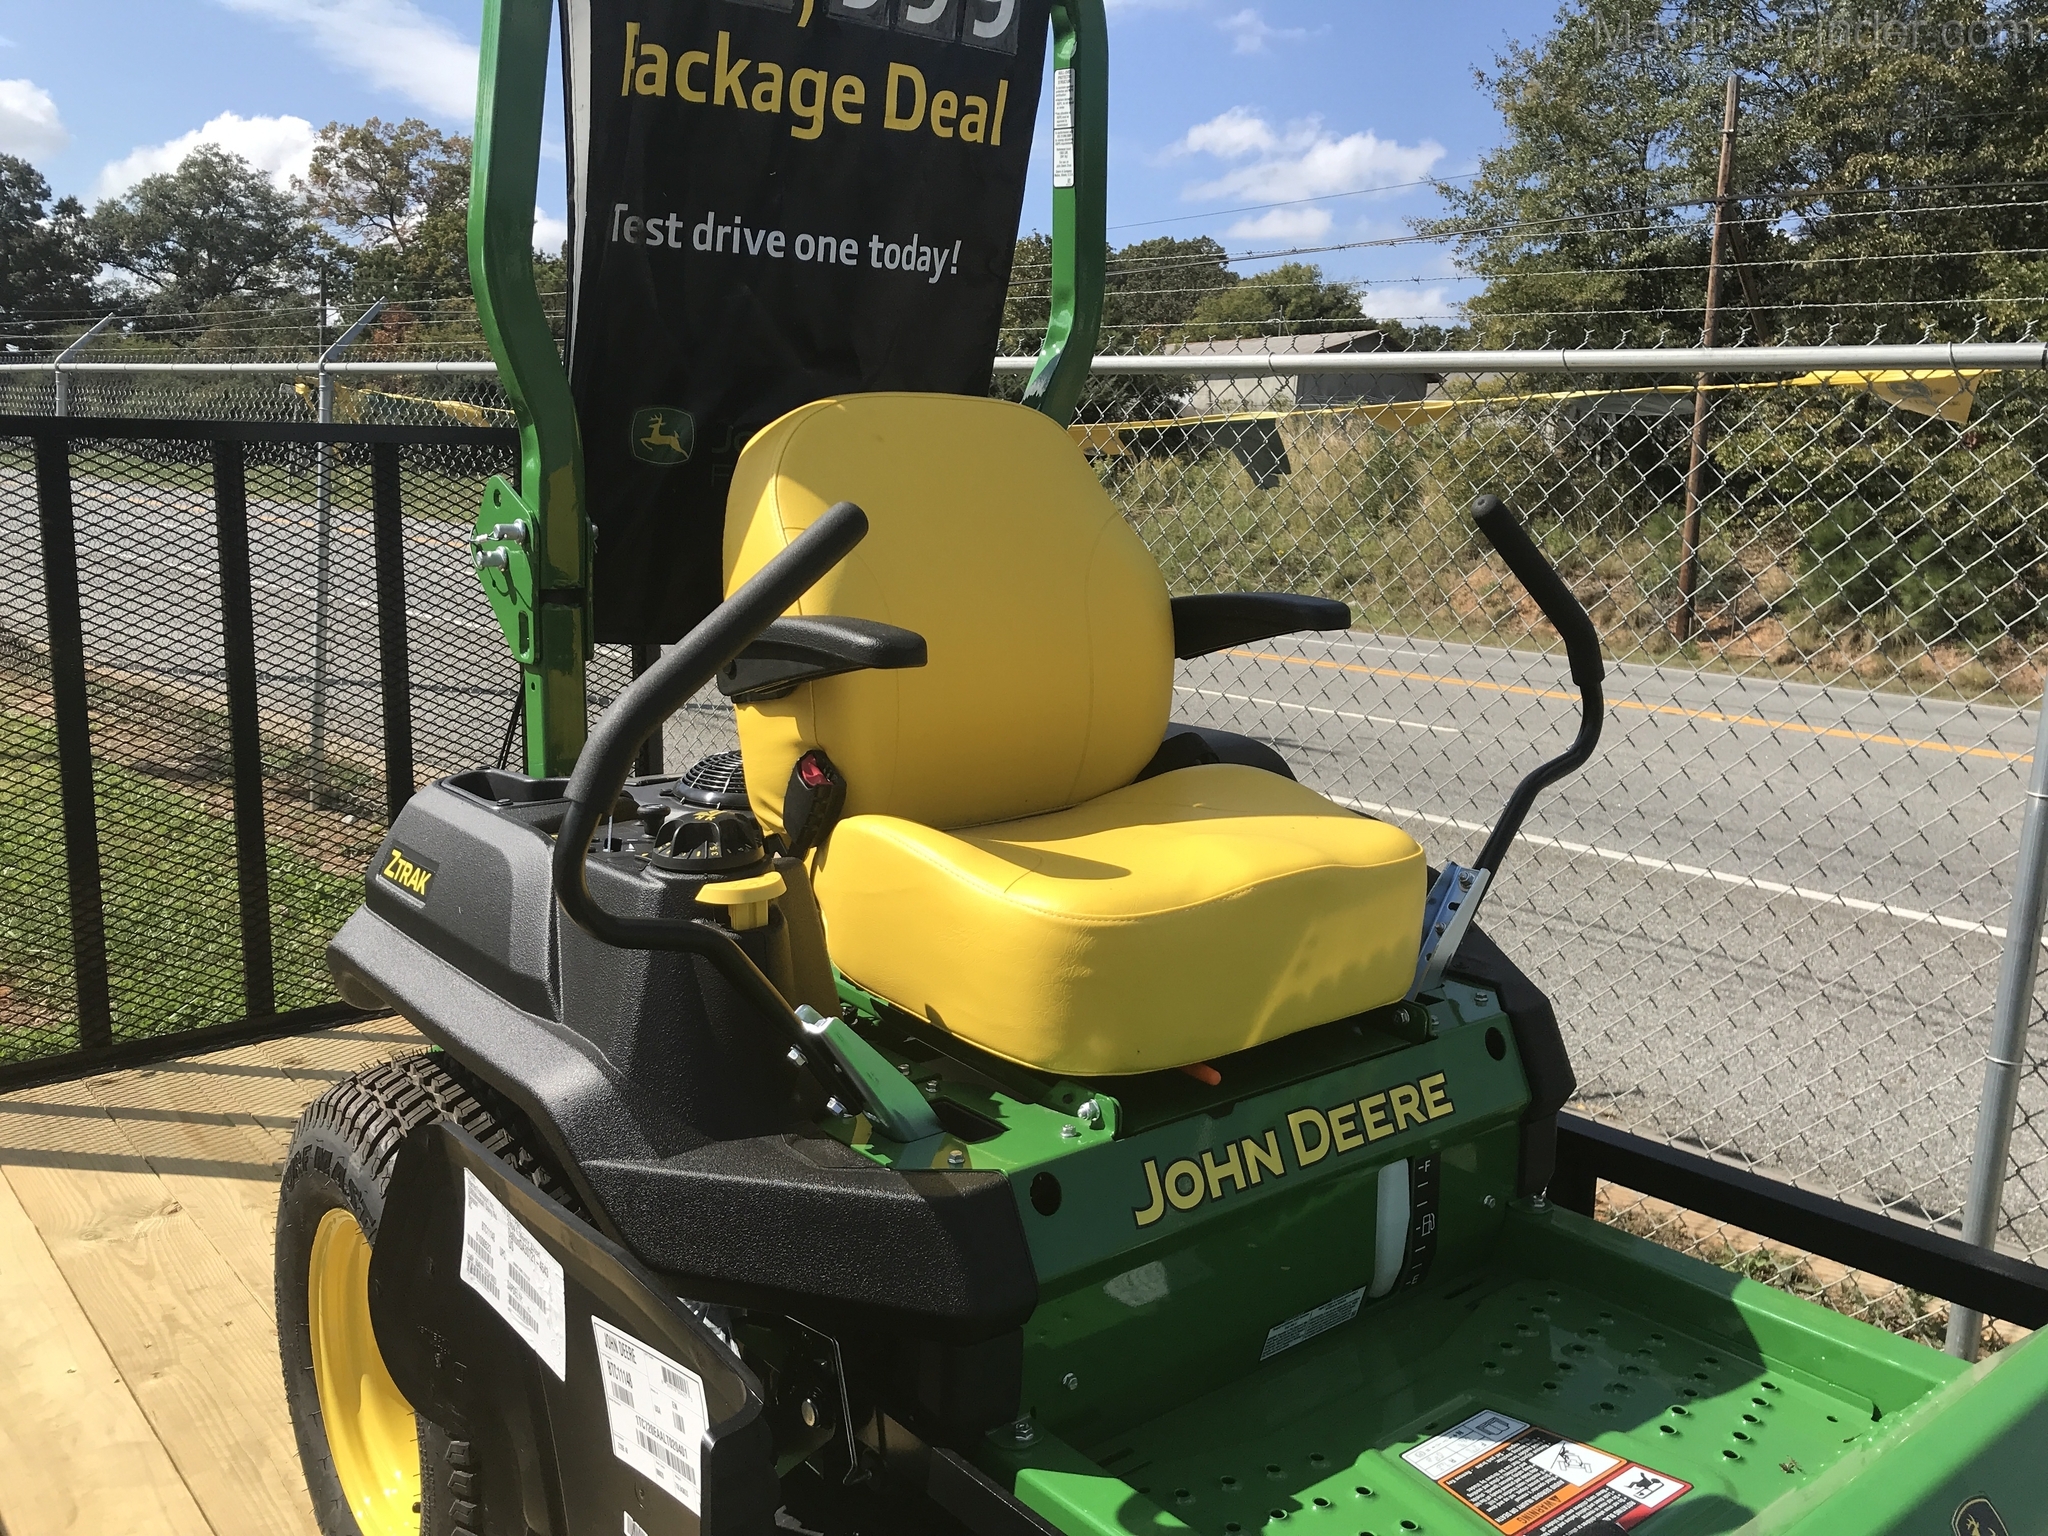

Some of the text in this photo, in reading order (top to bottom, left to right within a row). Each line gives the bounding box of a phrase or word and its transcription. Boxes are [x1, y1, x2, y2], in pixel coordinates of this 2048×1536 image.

[882, 62, 1010, 147] Deal
[692, 210, 786, 260] drive
[794, 231, 858, 266] one
[868, 232, 962, 284] today!
[383, 848, 432, 896] ZTRAK
[1133, 1070, 1456, 1229] JOHN DEERE
[617, 1339, 637, 1365] DEERE
[1514, 1499, 1556, 1524] WARNING
